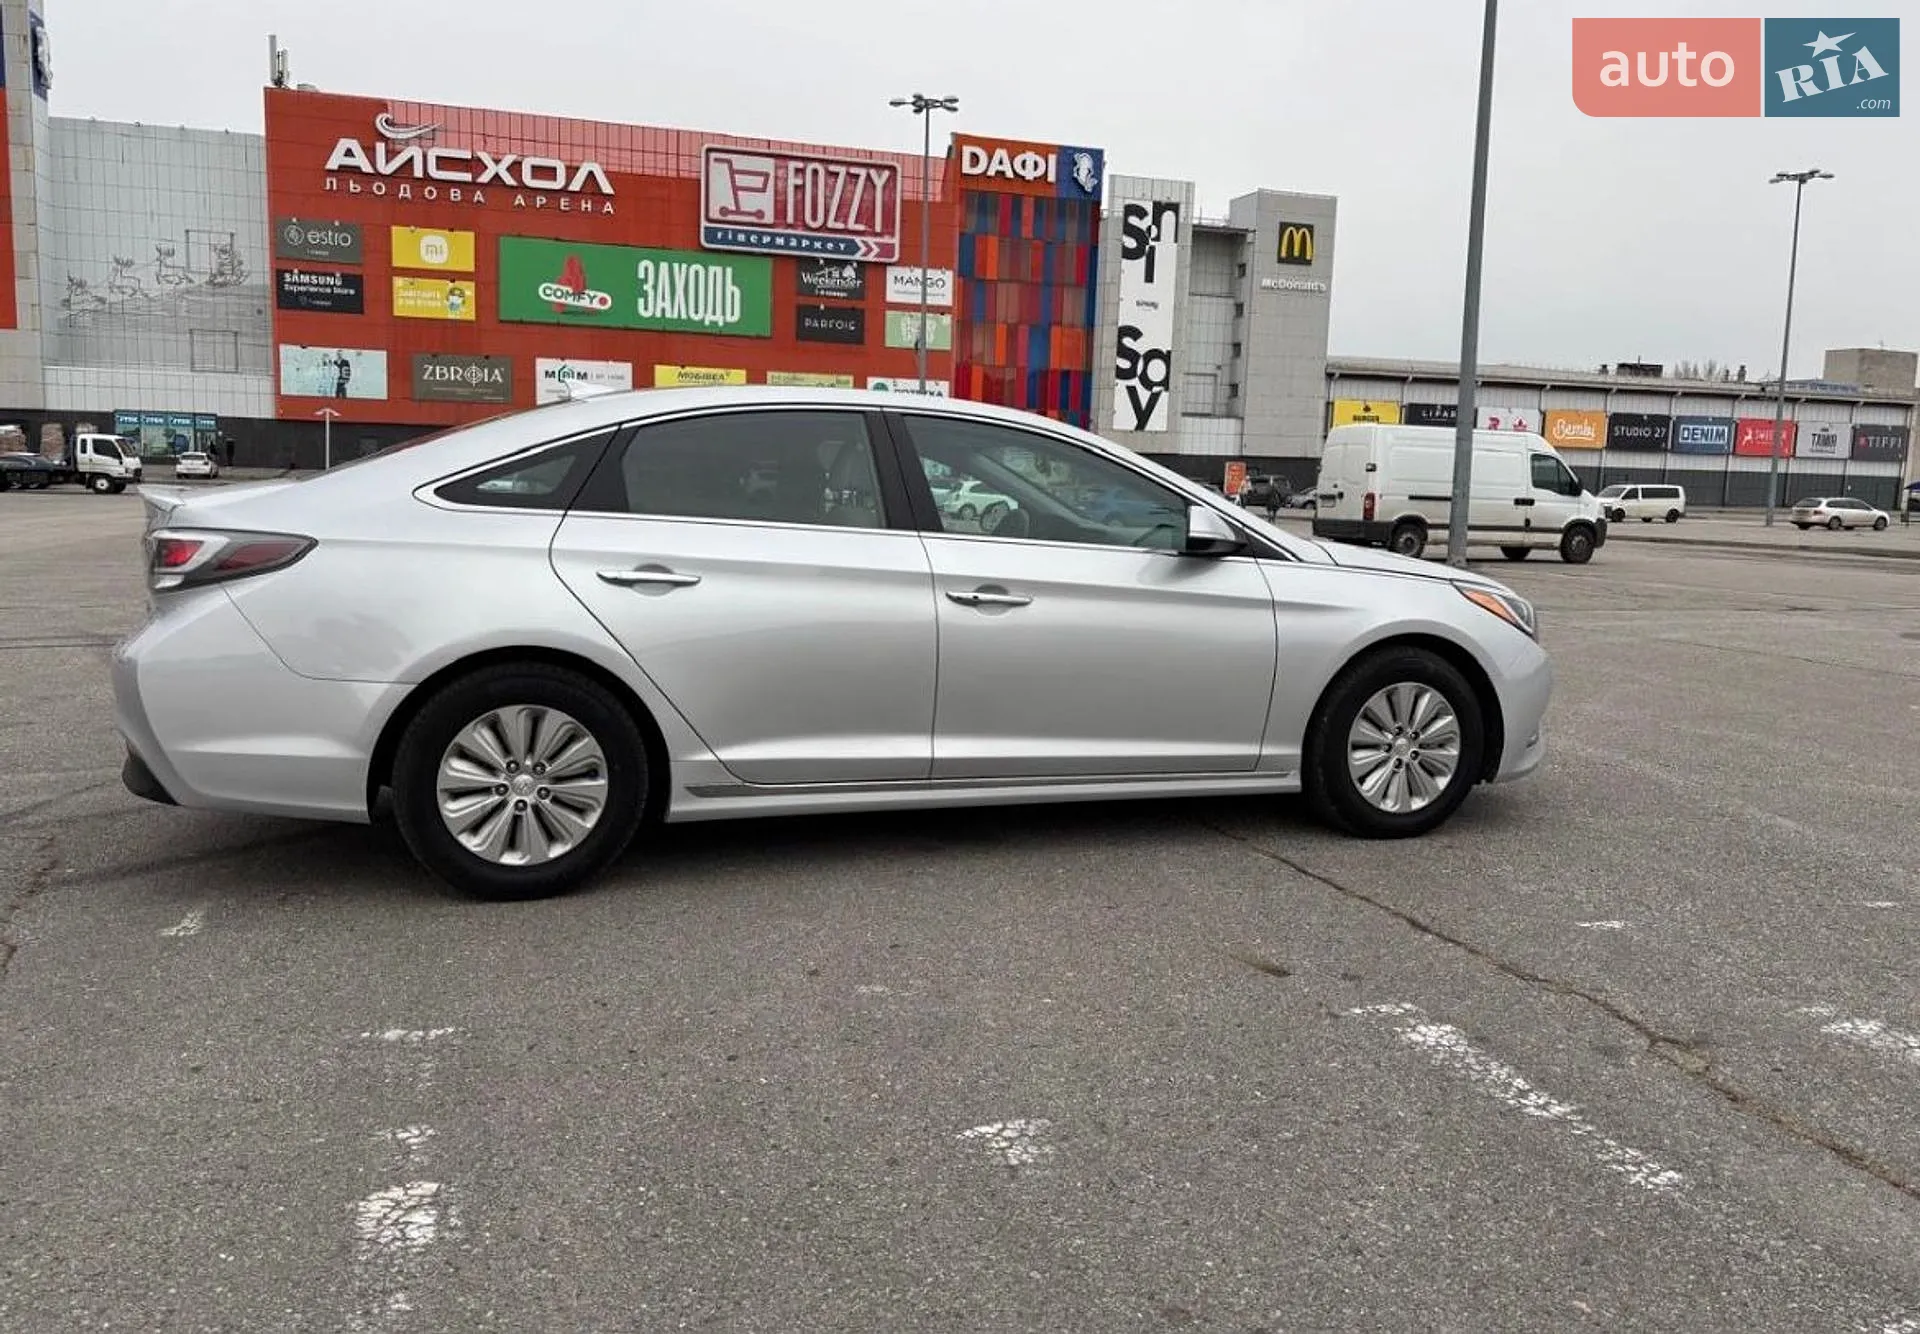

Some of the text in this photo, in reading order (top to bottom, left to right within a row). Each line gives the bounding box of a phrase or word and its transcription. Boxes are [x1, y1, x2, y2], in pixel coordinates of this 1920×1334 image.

[324, 176, 614, 214] ЛЬОДОВА АРЕНА
[786, 160, 891, 233] FOZZY
[716, 230, 846, 251] гіпермаркет
[284, 272, 343, 286] SAMSUNG
[894, 275, 946, 289] MANGO
[1261, 277, 1326, 292] McDonald's
[543, 286, 597, 305] COMFY
[637, 259, 741, 327] ЗАХОДЬ
[1614, 425, 1667, 438] STUDIO 27
[1681, 425, 1729, 443] DENIM
